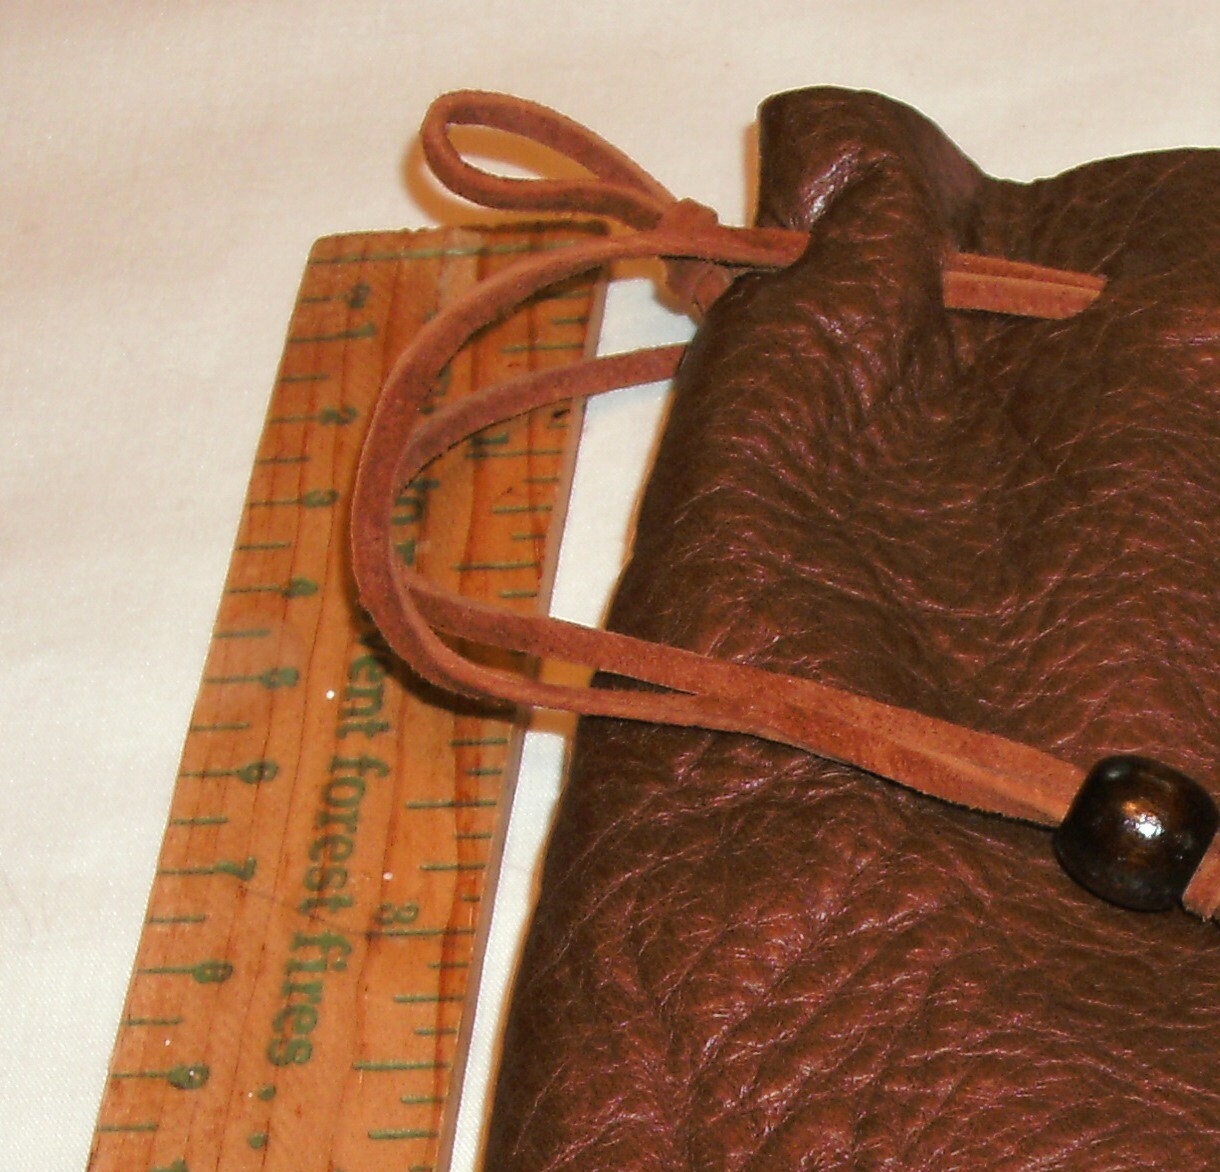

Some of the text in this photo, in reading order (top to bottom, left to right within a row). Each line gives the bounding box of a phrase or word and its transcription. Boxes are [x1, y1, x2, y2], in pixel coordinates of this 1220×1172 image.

[319, 406, 357, 426] 2
[262, 667, 300, 690] 5
[238, 759, 280, 785] 6
[299, 753, 391, 915] forest
[213, 856, 257, 881] 7
[376, 902, 420, 926] 3
